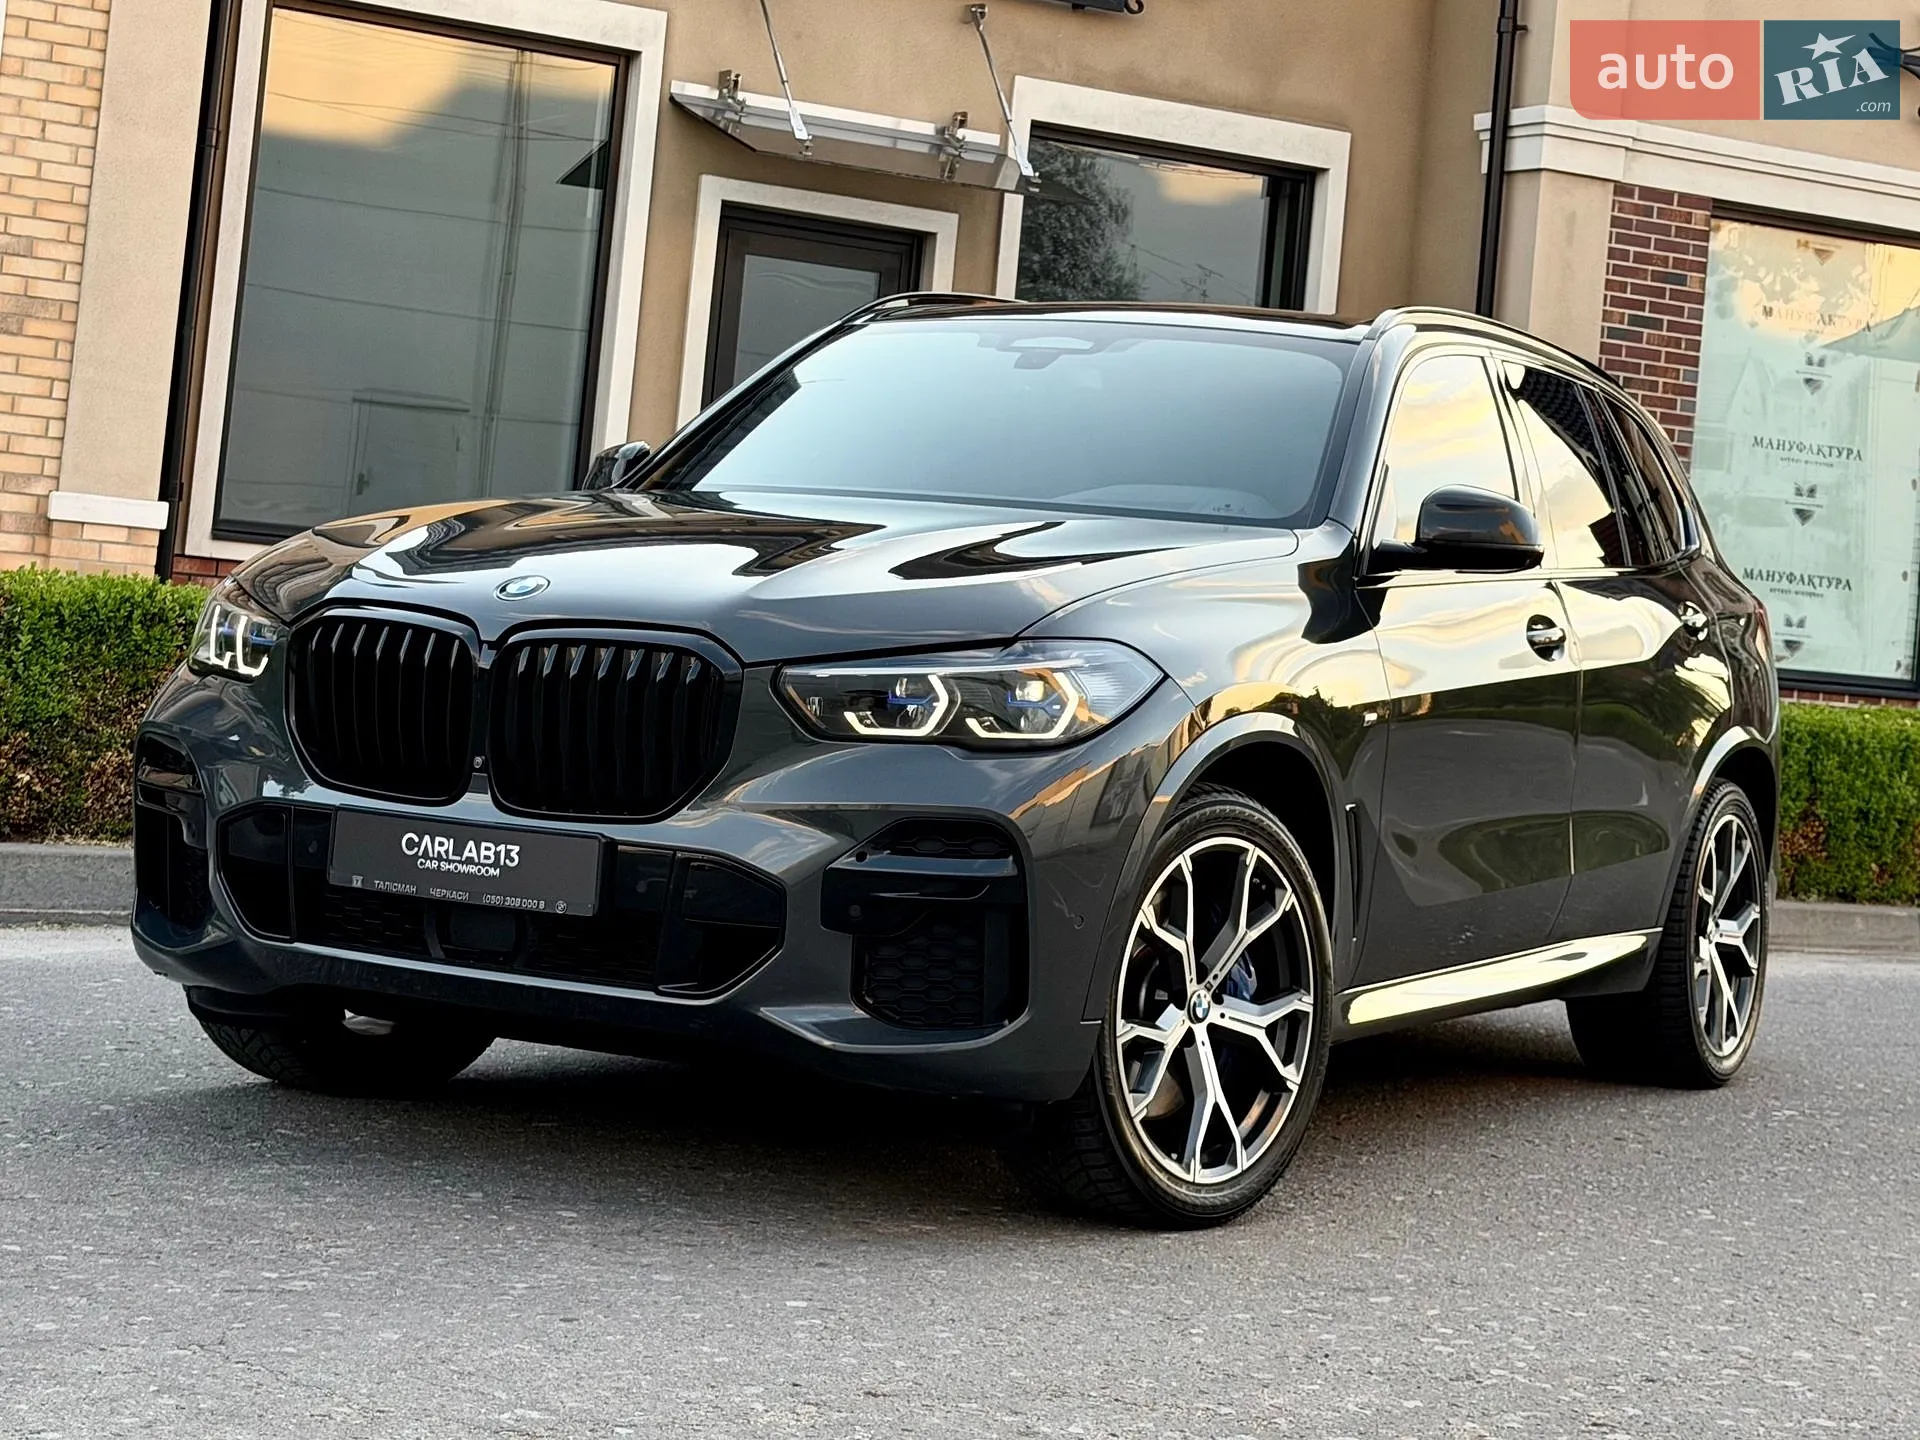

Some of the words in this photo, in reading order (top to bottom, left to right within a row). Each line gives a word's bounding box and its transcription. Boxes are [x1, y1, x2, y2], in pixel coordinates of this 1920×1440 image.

[1752, 435, 1863, 462] МАНУФАКТУРА
[1743, 567, 1853, 592] МАНУФАКТУРА
[401, 832, 520, 867] CARLAB13
[417, 858, 438, 870] CAR
[440, 861, 500, 878] SHOWROOM
[374, 879, 417, 895] ТАЛІСМАН
[429, 887, 469, 902] ЧЕРКАСИ
[482, 893, 504, 906] (050)
